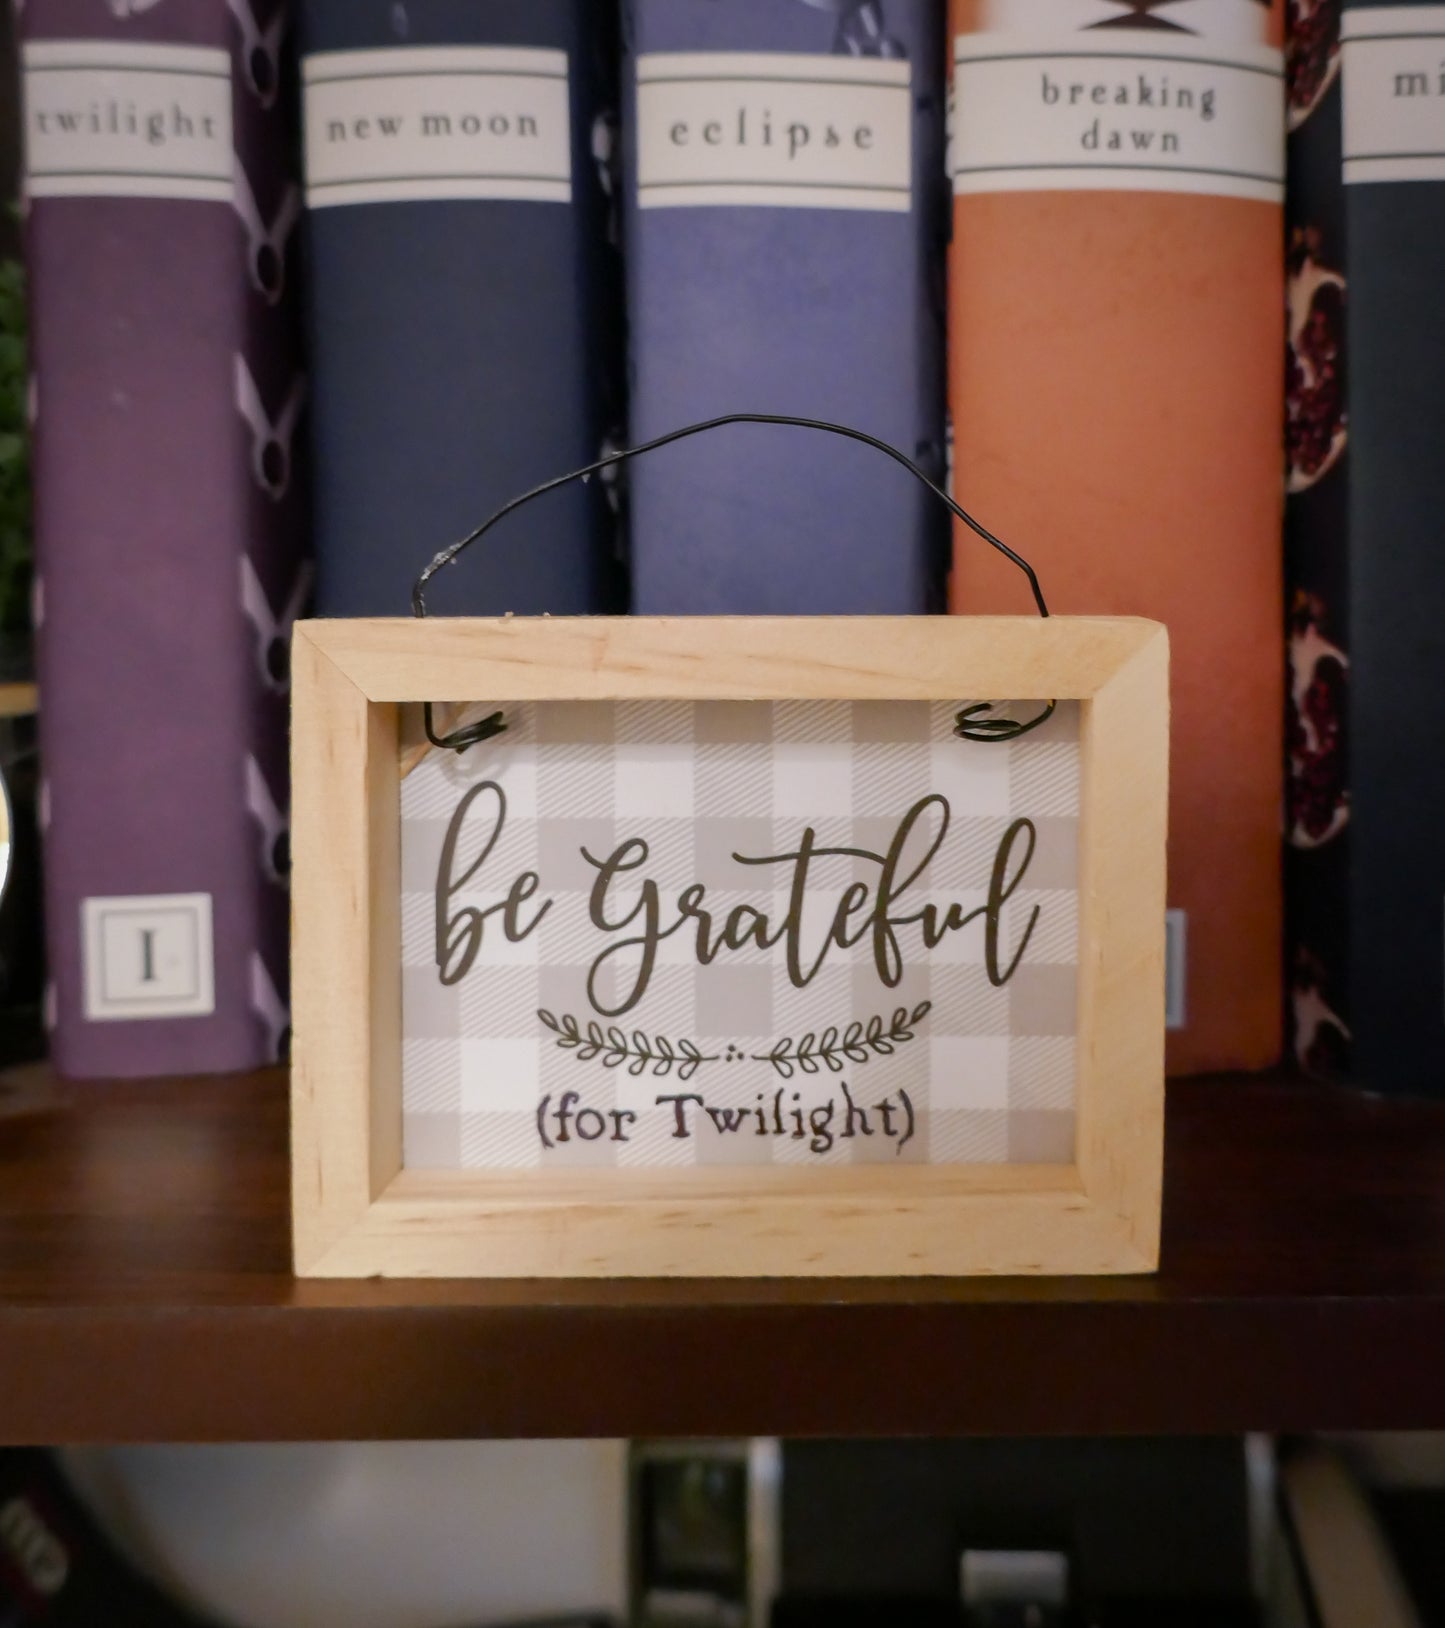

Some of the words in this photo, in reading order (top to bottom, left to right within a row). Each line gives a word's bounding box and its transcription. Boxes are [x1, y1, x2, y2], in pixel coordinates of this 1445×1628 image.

[1042, 74, 1216, 121] breaking
[36, 100, 218, 146] twilight
[327, 114, 402, 143] new
[421, 111, 539, 138] moon
[669, 106, 874, 160] eclipse
[1081, 118, 1180, 153] dawn
[435, 780, 553, 985] be
[536, 1091, 637, 1149] (for
[655, 1081, 915, 1154] Twilight)
